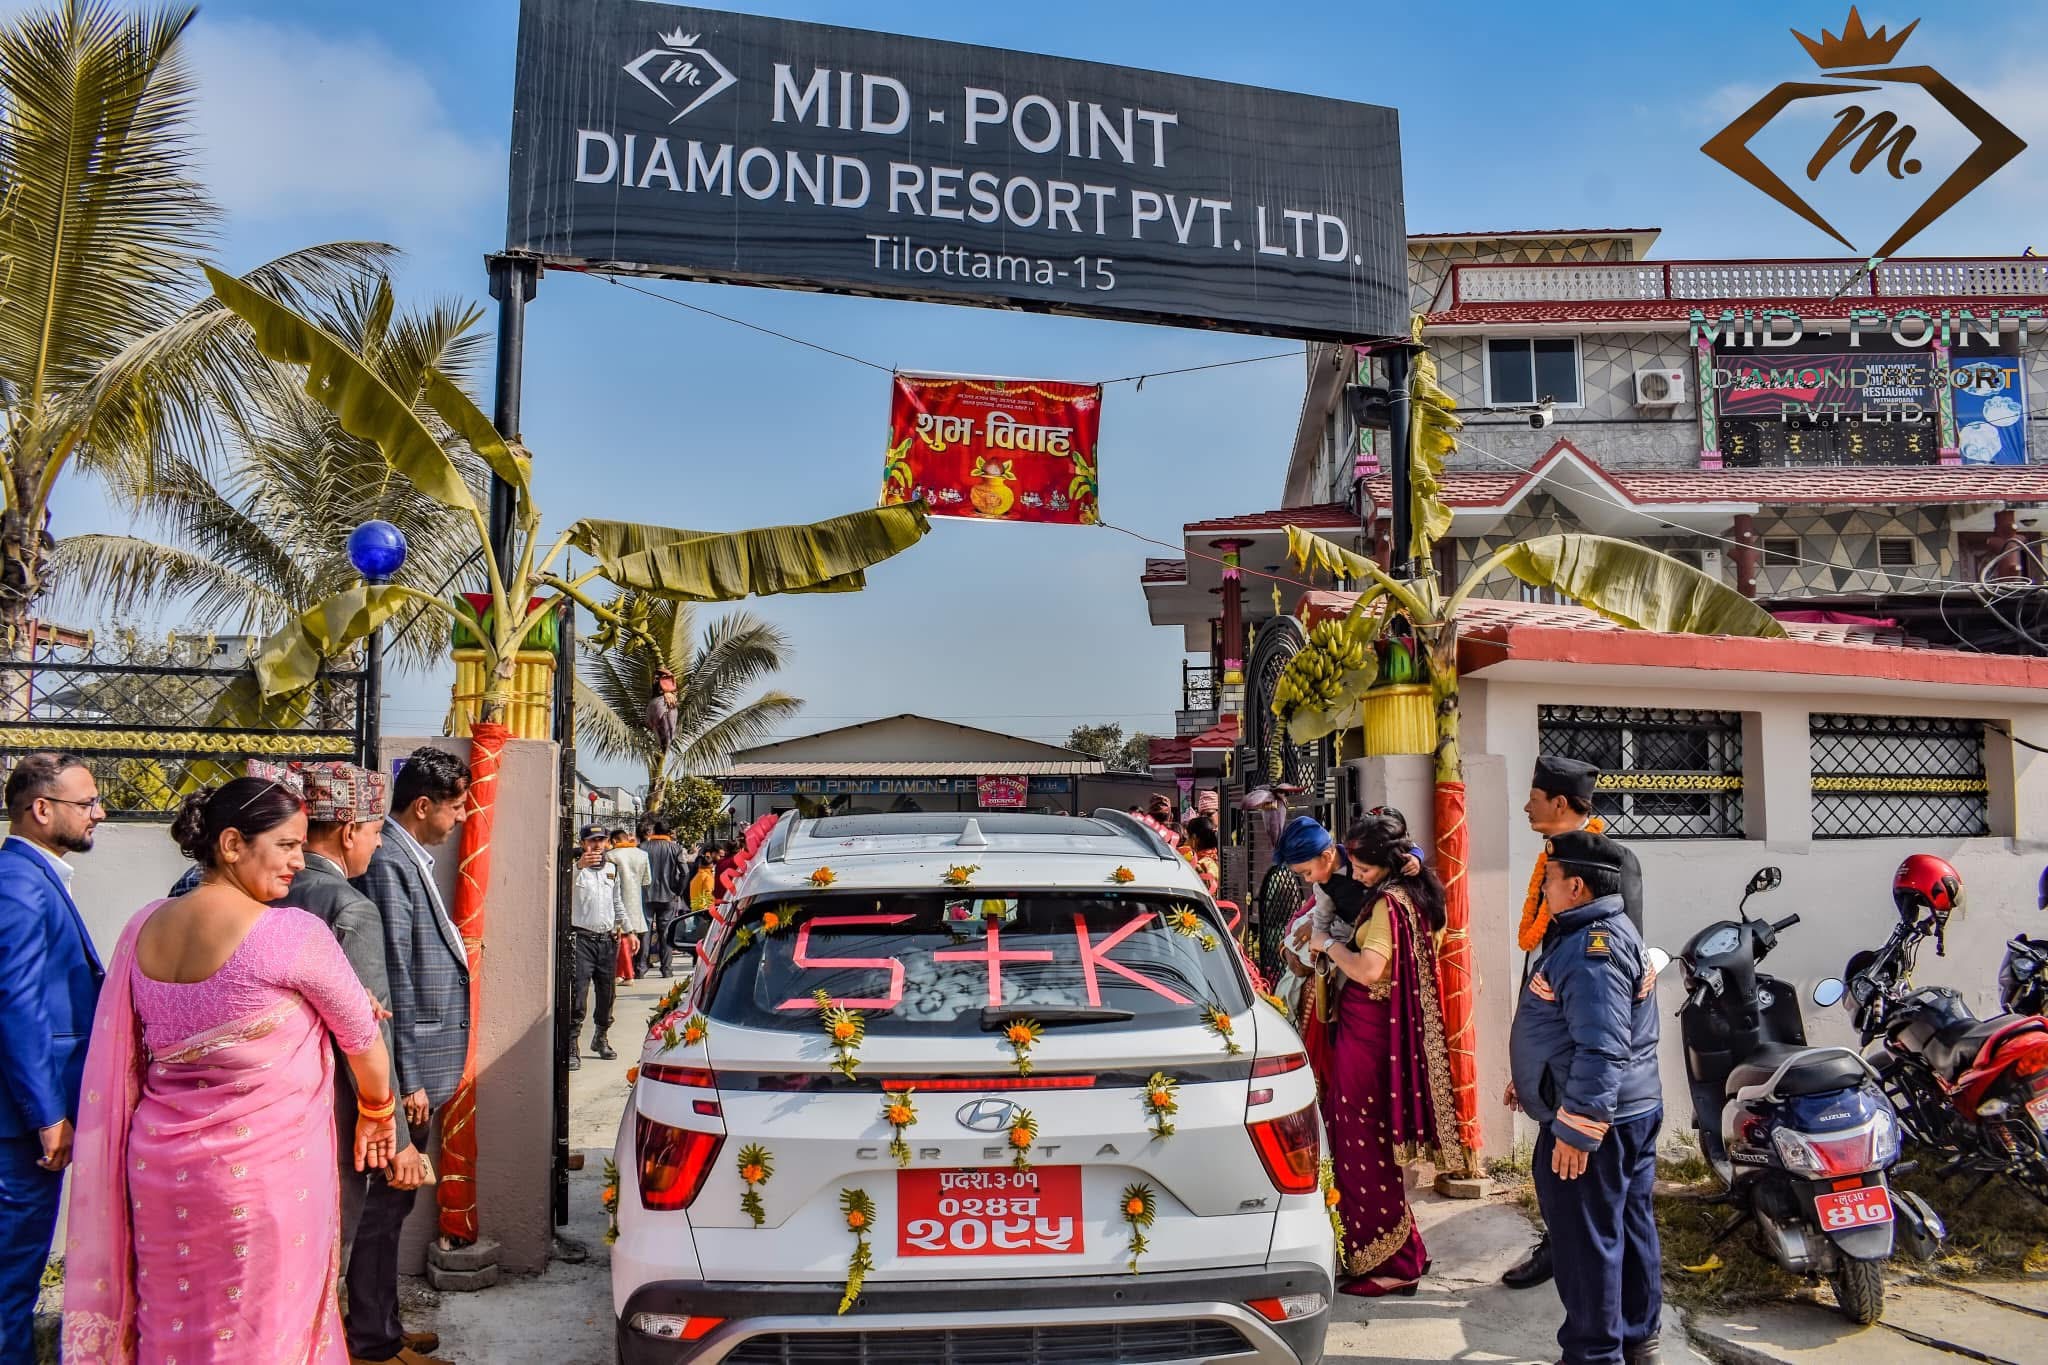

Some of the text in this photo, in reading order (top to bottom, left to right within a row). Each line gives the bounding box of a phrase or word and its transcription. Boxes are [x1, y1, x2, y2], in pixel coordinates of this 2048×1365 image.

[771, 63, 911, 134] MID
[963, 86, 1179, 168] POINT
[574, 129, 1362, 266] DIAMOND RESORT PVT. LTD.
[865, 234, 1116, 292] Tilottama-15
[1862, 386, 1923, 398] RESTAURANT
[795, 780, 821, 793] MID
[826, 780, 874, 793] POINT
[880, 779, 949, 793] DIAMOND
[1073, 911, 1195, 1008] K
[856, 1143, 1120, 1161] CRETA
